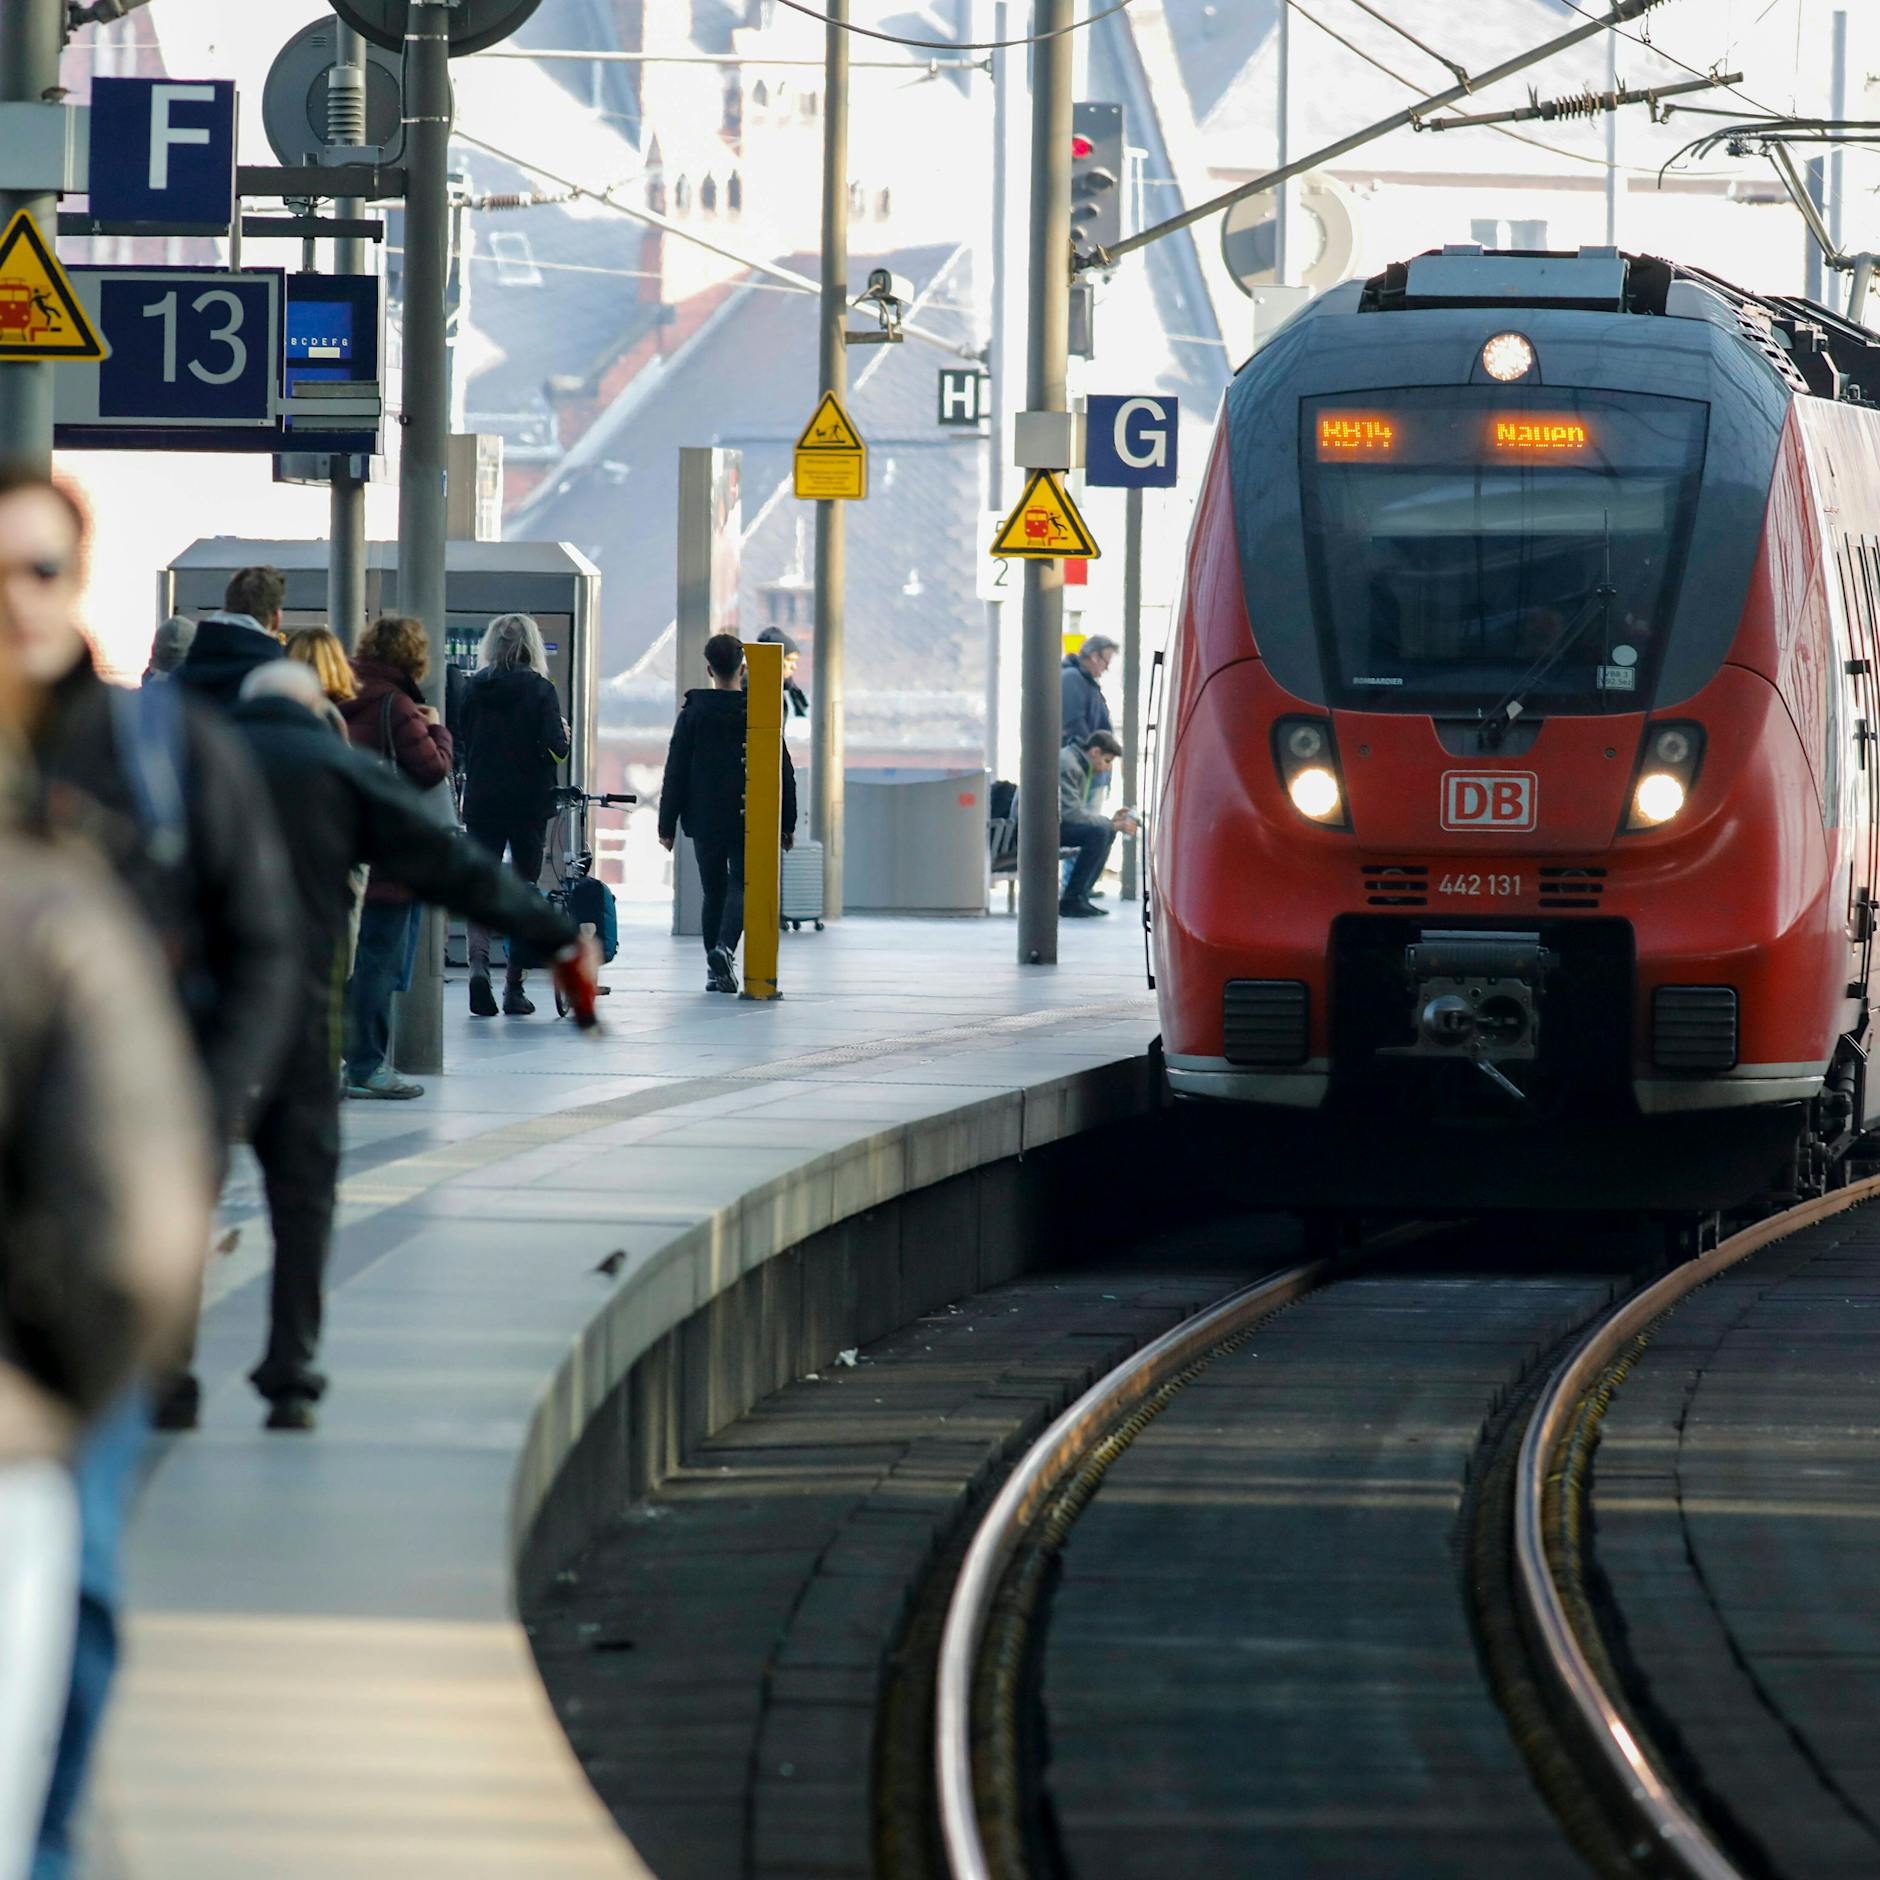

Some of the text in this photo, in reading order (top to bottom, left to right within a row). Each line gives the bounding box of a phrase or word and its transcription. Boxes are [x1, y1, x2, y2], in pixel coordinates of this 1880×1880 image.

[149, 84, 216, 190] F
[142, 289, 248, 385] 13
[301, 337, 308, 346] C
[311, 337, 318, 346] D
[321, 338, 328, 346] E
[331, 338, 338, 346] F
[942, 374, 976, 419] H
[1113, 397, 1167, 469] G
[992, 557, 1009, 587] 2
[1454, 781, 1524, 821] DB
[1438, 873, 1521, 896] 442 131
